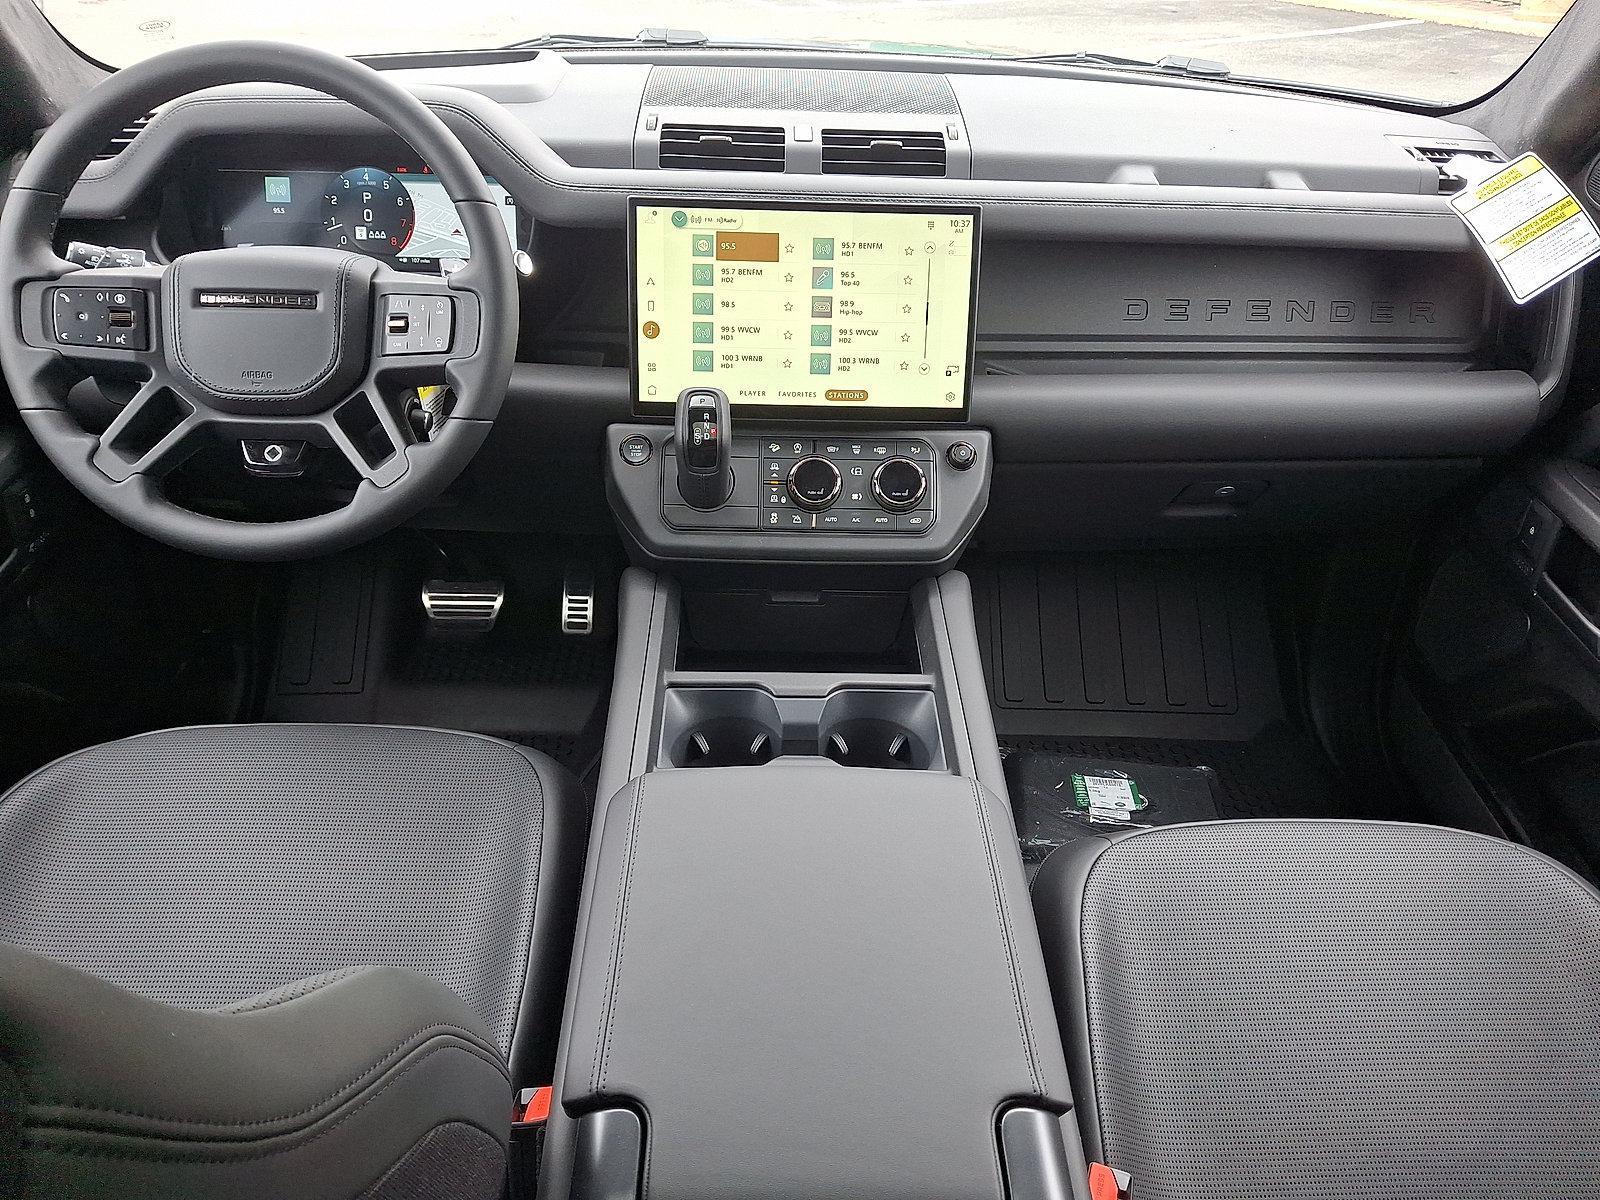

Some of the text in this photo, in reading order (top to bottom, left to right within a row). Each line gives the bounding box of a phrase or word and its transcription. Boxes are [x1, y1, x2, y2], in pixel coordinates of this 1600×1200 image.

[363, 172, 369, 180] 4
[344, 180, 350, 188] 3
[384, 180, 390, 190] 5
[330, 196, 338, 204] 2
[362, 192, 372, 204] P
[396, 197, 404, 206] 6
[364, 208, 372, 222] 0
[331, 217, 336, 226] 1
[402, 218, 406, 227] 7
[950, 220, 970, 228] 10:37
[340, 236, 346, 244] 0
[390, 236, 397, 246] 8
[200, 292, 312, 306] ENDER
[1122, 298, 1436, 324] DEFENDER
[241, 370, 273, 379] AIRBAG
